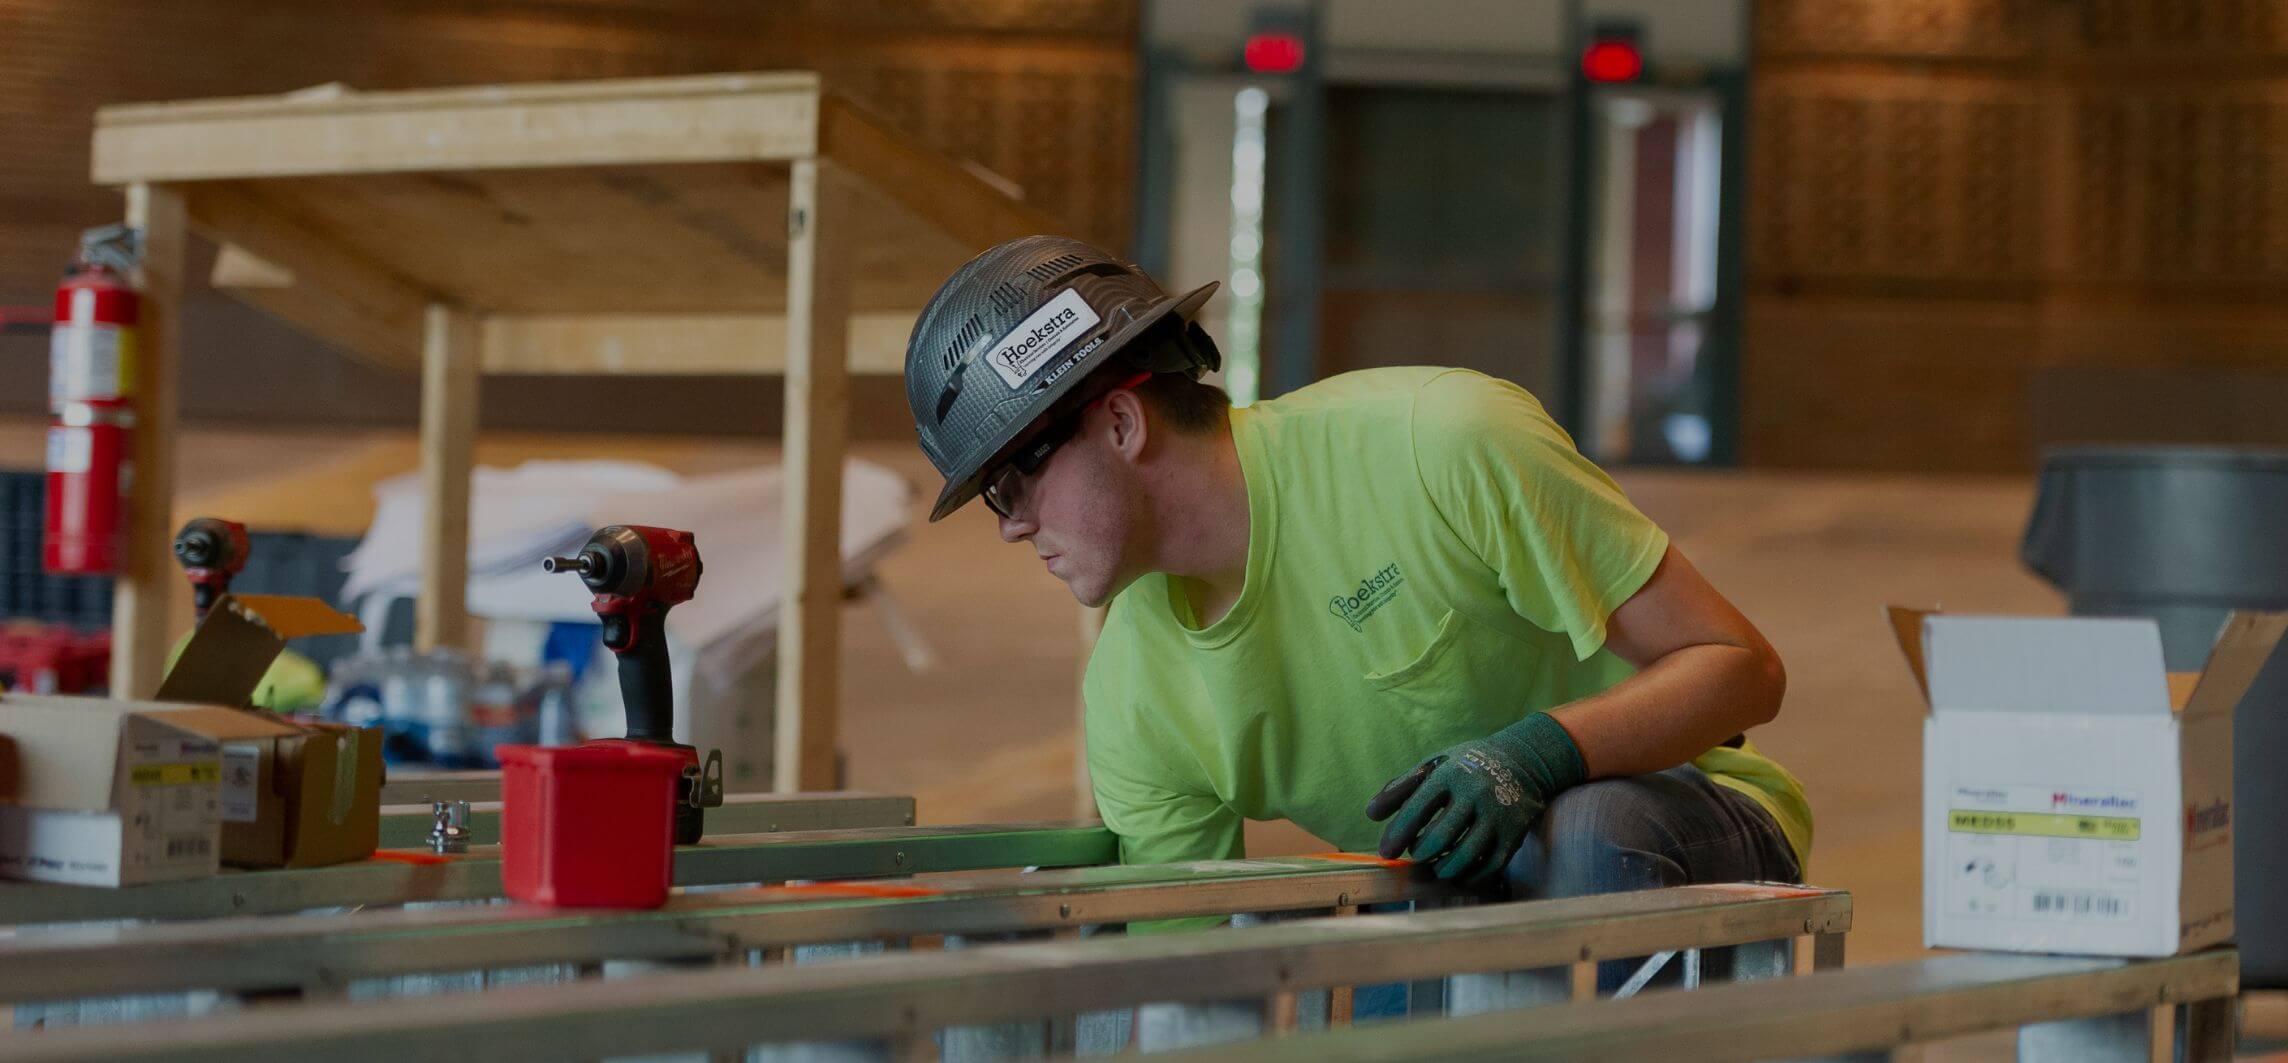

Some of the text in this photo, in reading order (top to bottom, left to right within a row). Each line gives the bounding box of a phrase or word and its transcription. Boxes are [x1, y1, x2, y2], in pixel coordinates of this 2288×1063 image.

[1002, 308, 1075, 366] Hoekstra
[1045, 359, 1075, 385] KLEIN
[1334, 562, 1400, 616] Hoekstra
